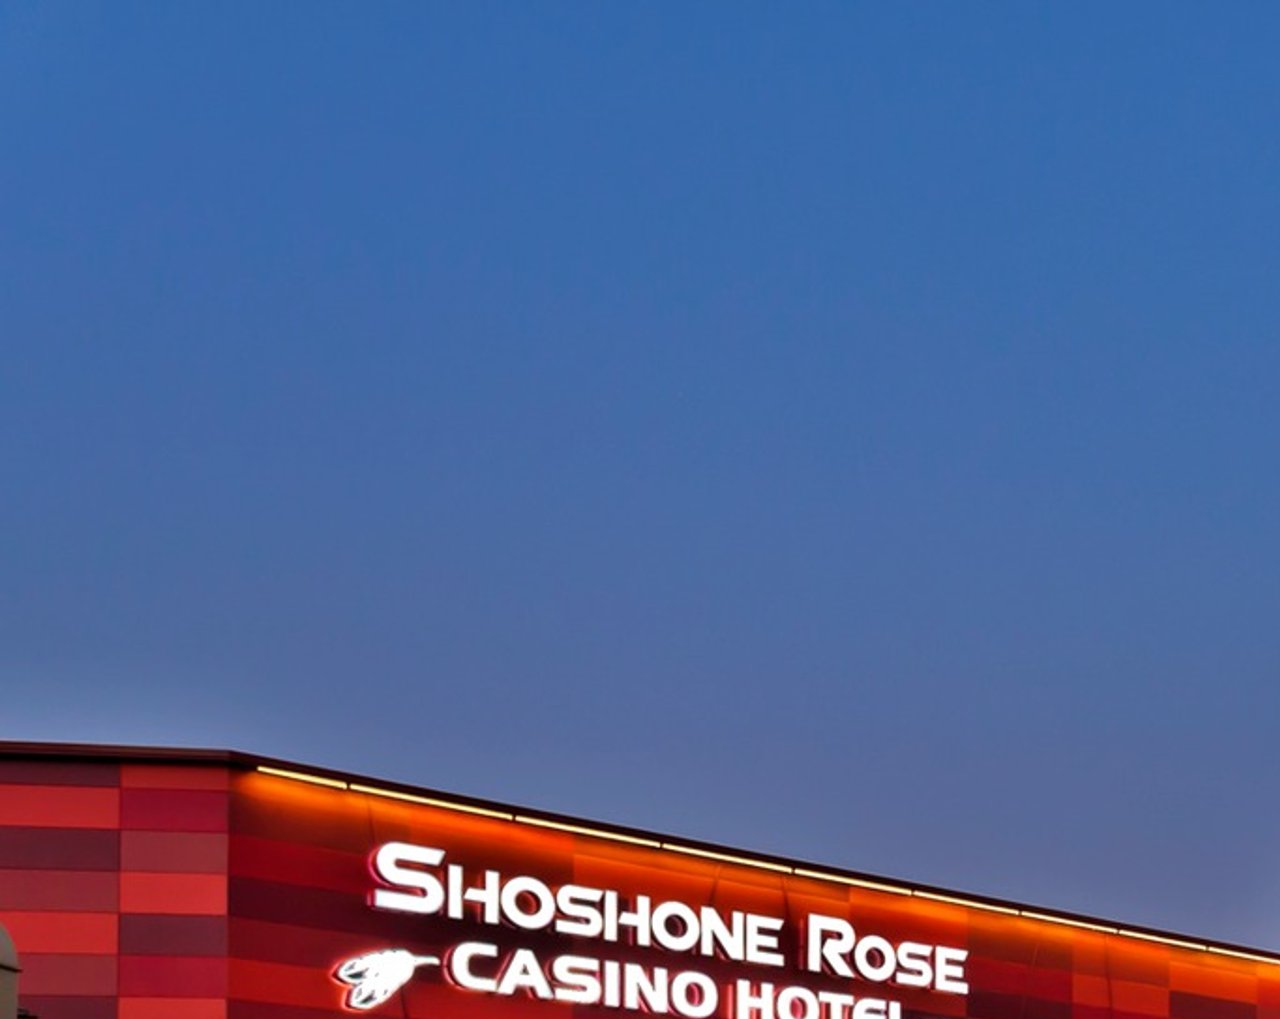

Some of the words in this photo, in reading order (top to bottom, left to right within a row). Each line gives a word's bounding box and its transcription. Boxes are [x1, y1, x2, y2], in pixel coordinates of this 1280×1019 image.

[374, 841, 785, 967] SHOSHONE
[806, 913, 969, 995] ROSE
[450, 942, 718, 1019] CASINO
